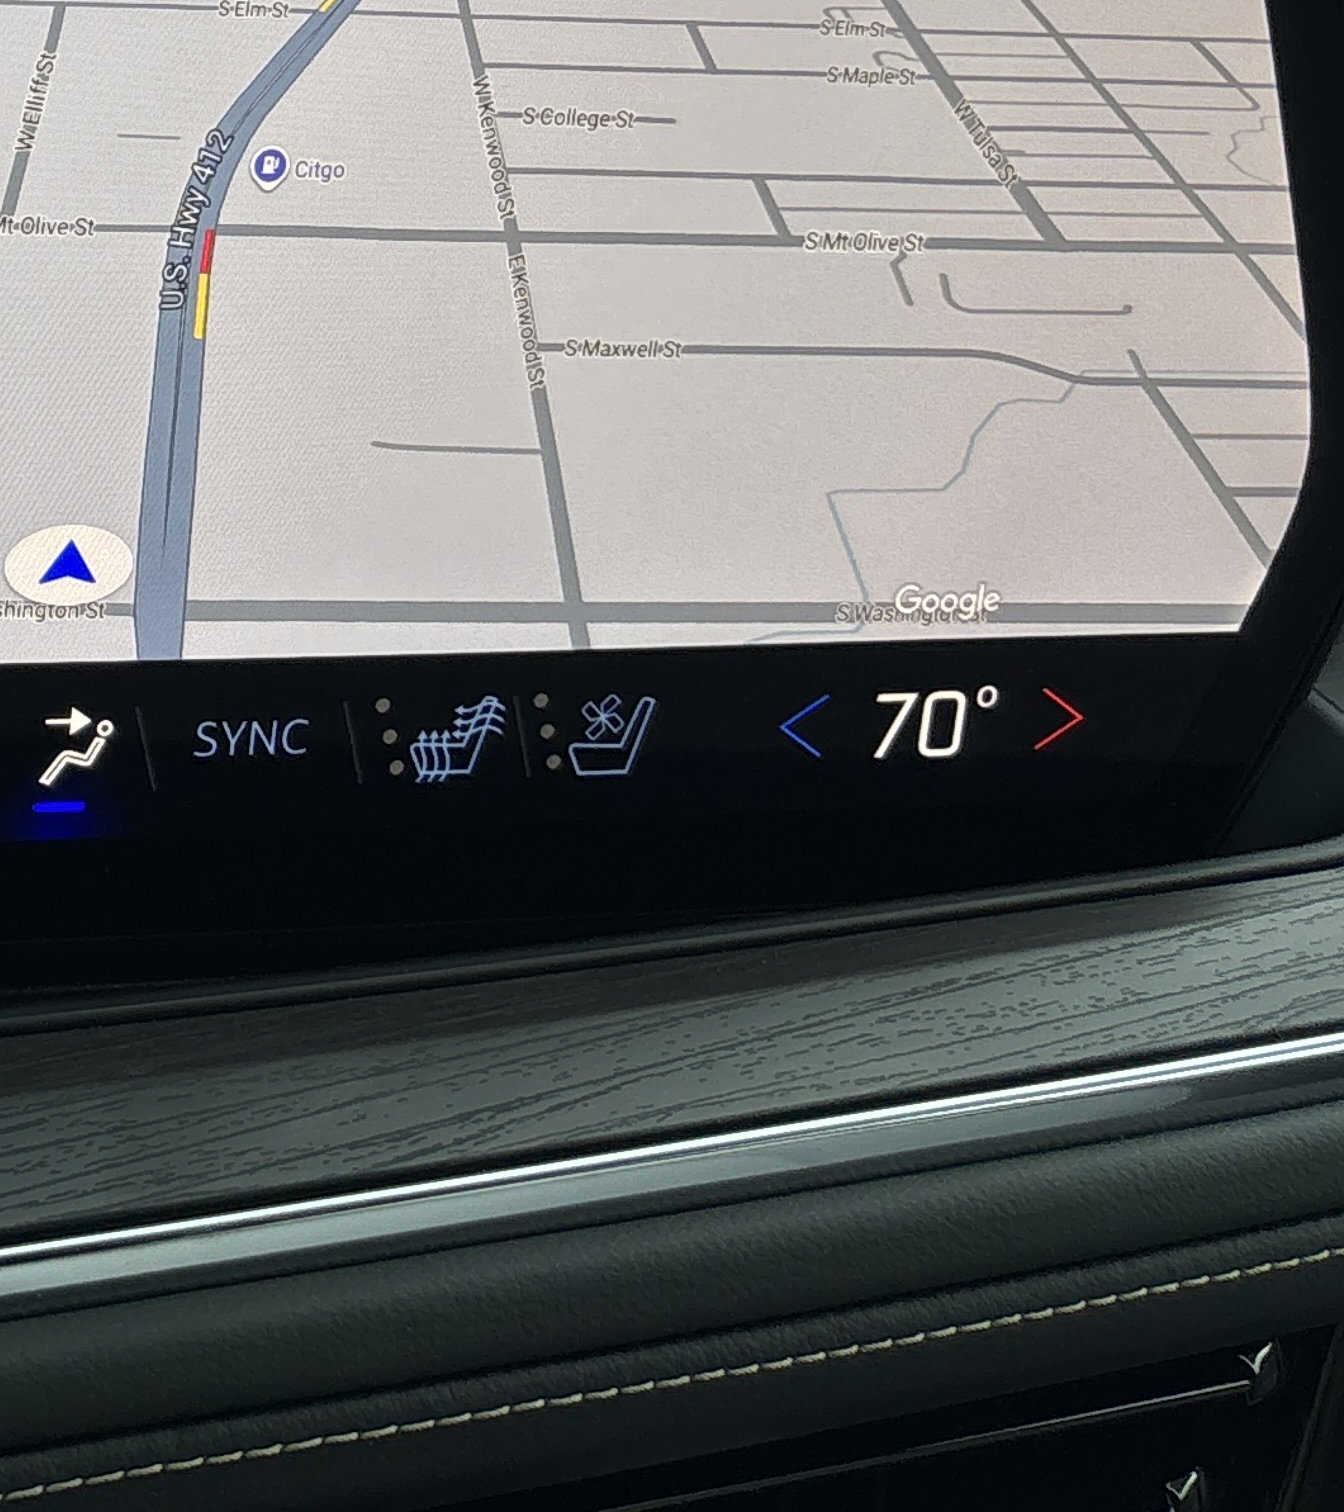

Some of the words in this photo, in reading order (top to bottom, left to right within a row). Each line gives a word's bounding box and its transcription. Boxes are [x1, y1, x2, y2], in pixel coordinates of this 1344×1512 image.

[219, 0, 230, 16] S
[235, 0, 267, 17] Elm
[272, 1, 289, 18] St
[36, 51, 57, 74] St
[472, 76, 491, 97] W
[827, 67, 839, 83] S
[843, 67, 895, 87] Maple
[899, 69, 915, 85] St
[22, 78, 51, 126] Elliff
[523, 107, 536, 124] S
[540, 108, 611, 131] College
[615, 110, 635, 128] St
[15, 131, 36, 153] W
[478, 100, 511, 192] Kenwood
[952, 99, 973, 121] W
[968, 117, 1003, 168] Tulsa
[996, 164, 1019, 189] St
[195, 128, 233, 184] 412
[294, 160, 345, 182] Citgo
[169, 187, 211, 249] Hwy
[497, 196, 516, 219] St
[20, 217, 69, 236] Olive
[74, 219, 94, 237] St
[804, 232, 818, 251] S
[823, 232, 849, 252] Mt
[853, 232, 899, 252] Olive
[904, 233, 924, 253] St
[159, 254, 192, 311] U.S.
[564, 339, 577, 357] S
[582, 339, 656, 359] Maxwell
[661, 341, 682, 360] St
[84, 601, 105, 619] St
[895, 583, 1001, 620] Google
[872, 685, 998, 760] 70°
[193, 719, 311, 759] SYNC
